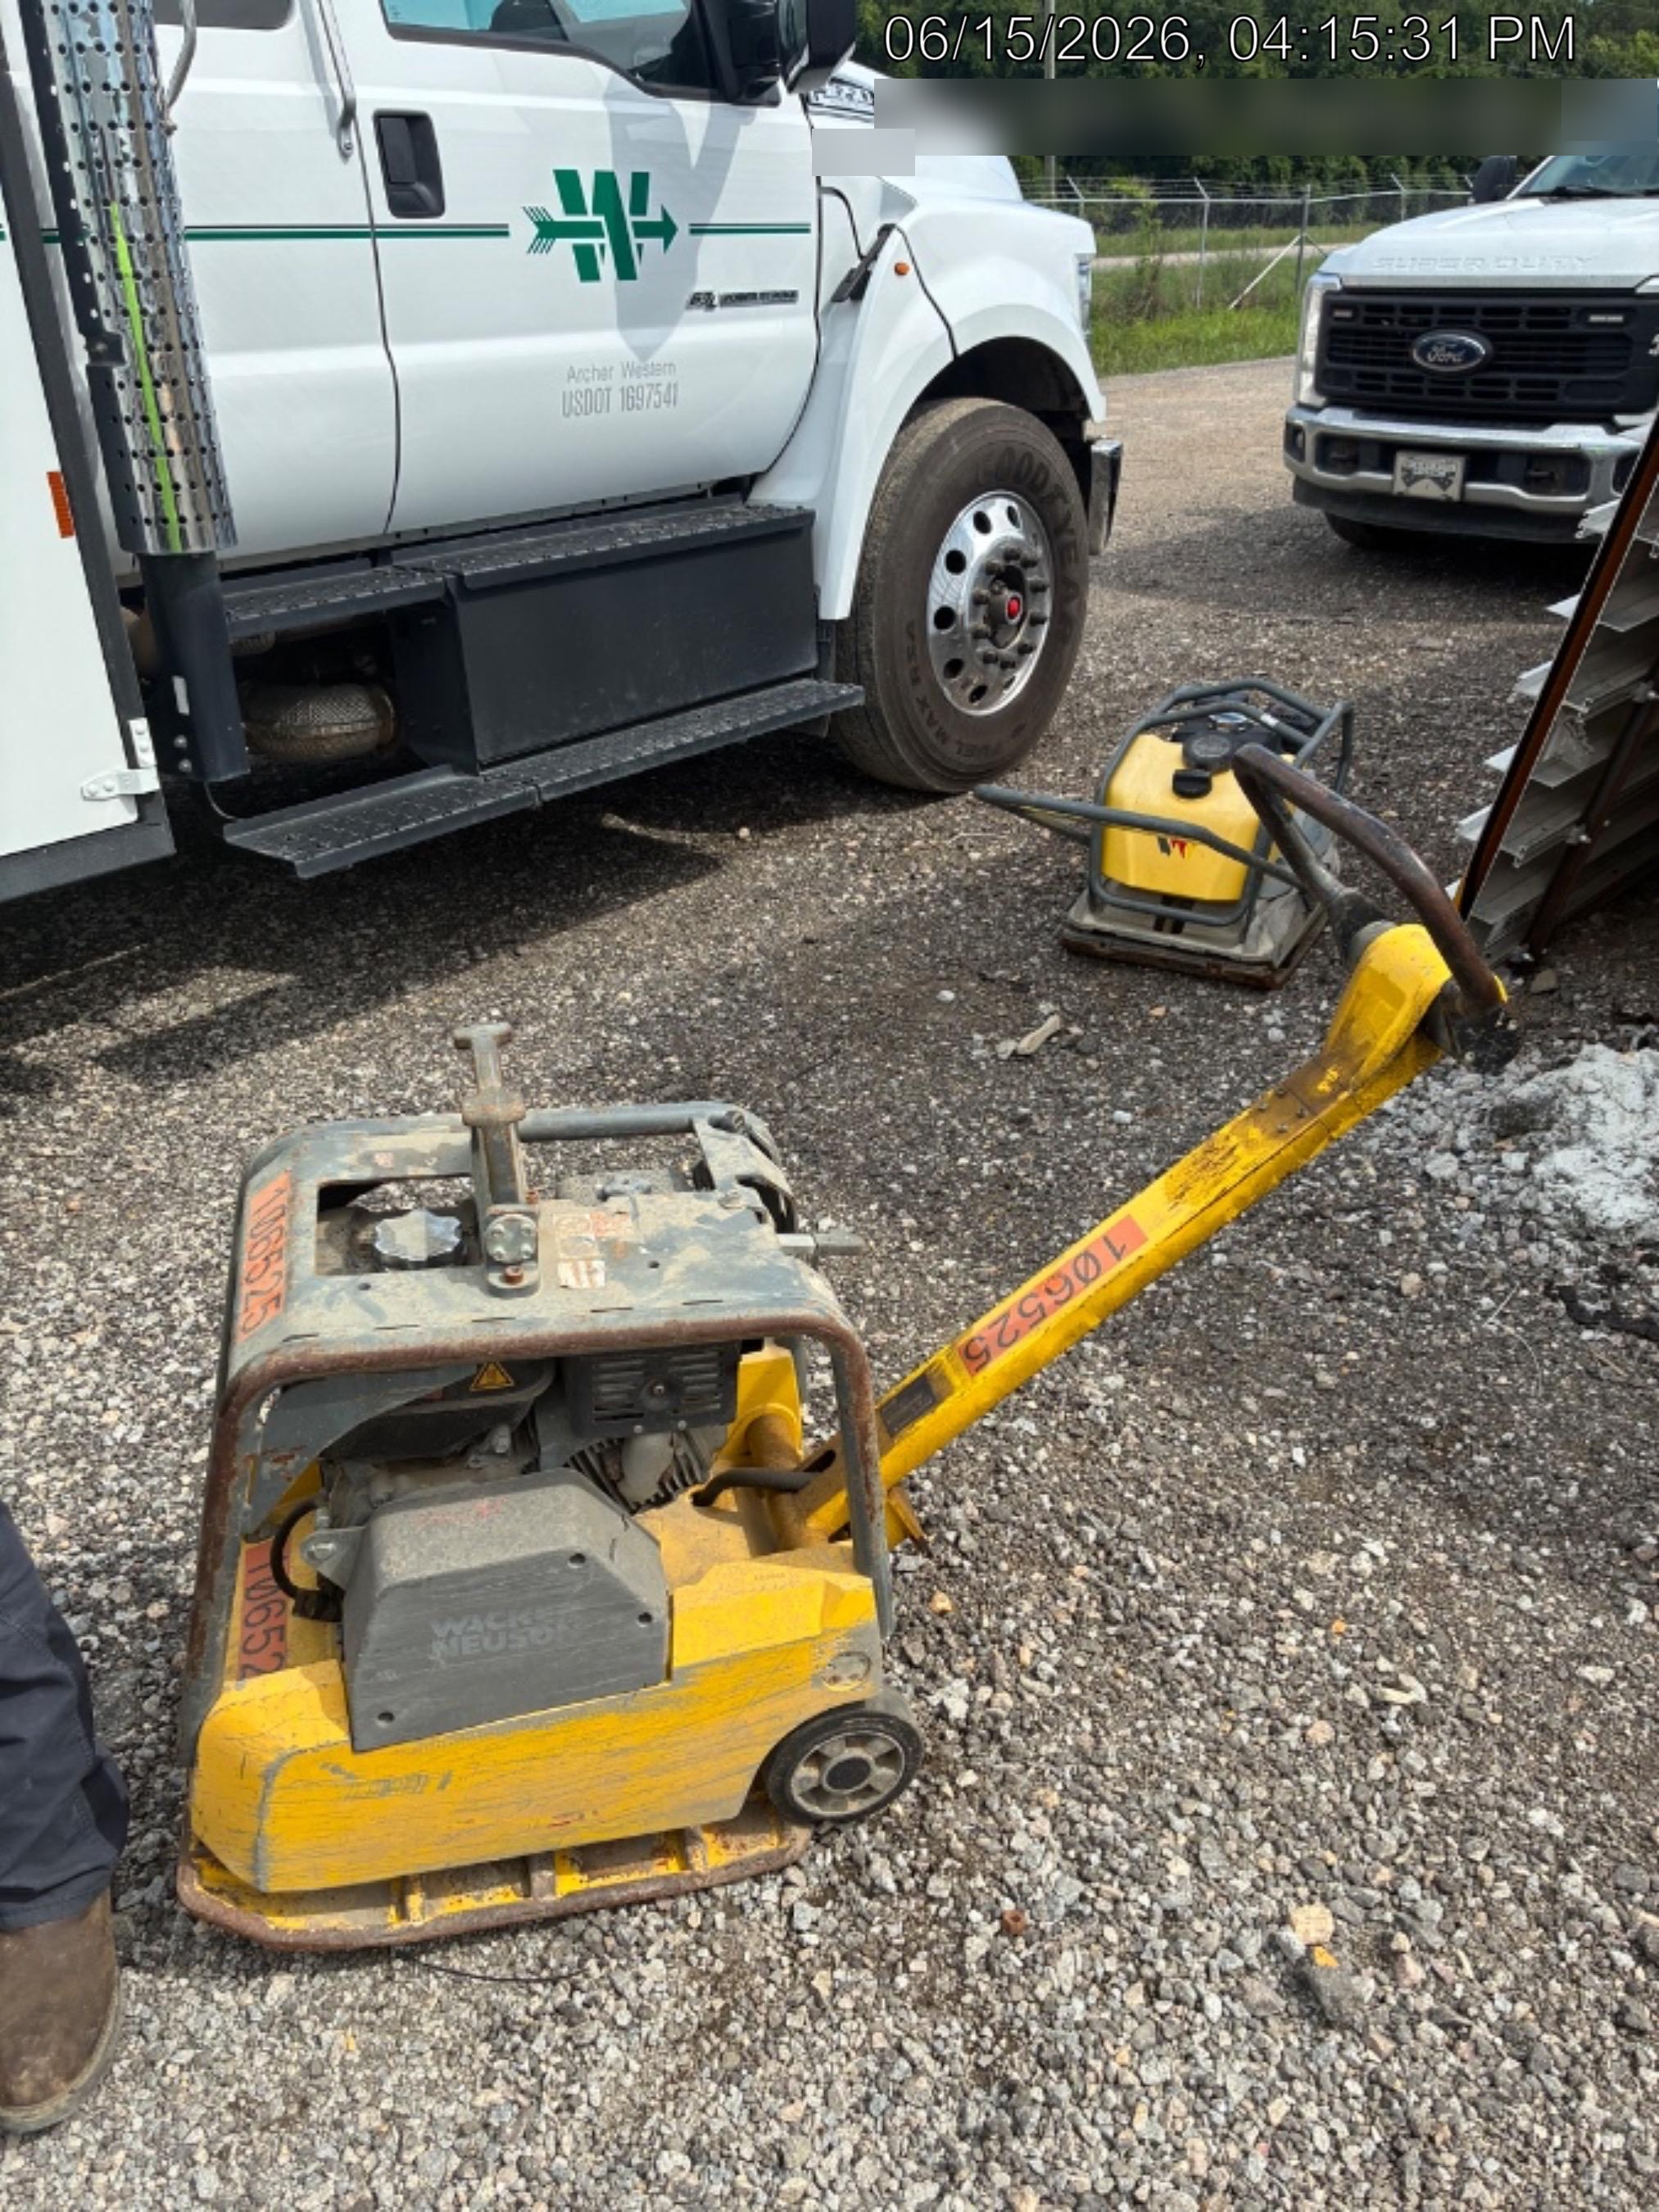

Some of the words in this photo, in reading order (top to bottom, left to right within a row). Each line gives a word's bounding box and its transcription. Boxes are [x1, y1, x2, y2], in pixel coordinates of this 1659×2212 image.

[1426, 341, 1466, 362] Ford
[567, 363, 614, 383] Archer
[620, 360, 677, 379] Western
[562, 387, 612, 419] USDOT
[619, 381, 678, 412] 1697541
[242, 1187, 287, 1333] 106525
[963, 1235, 1126, 1373] 106525
[430, 1607, 560, 1638] WACK
